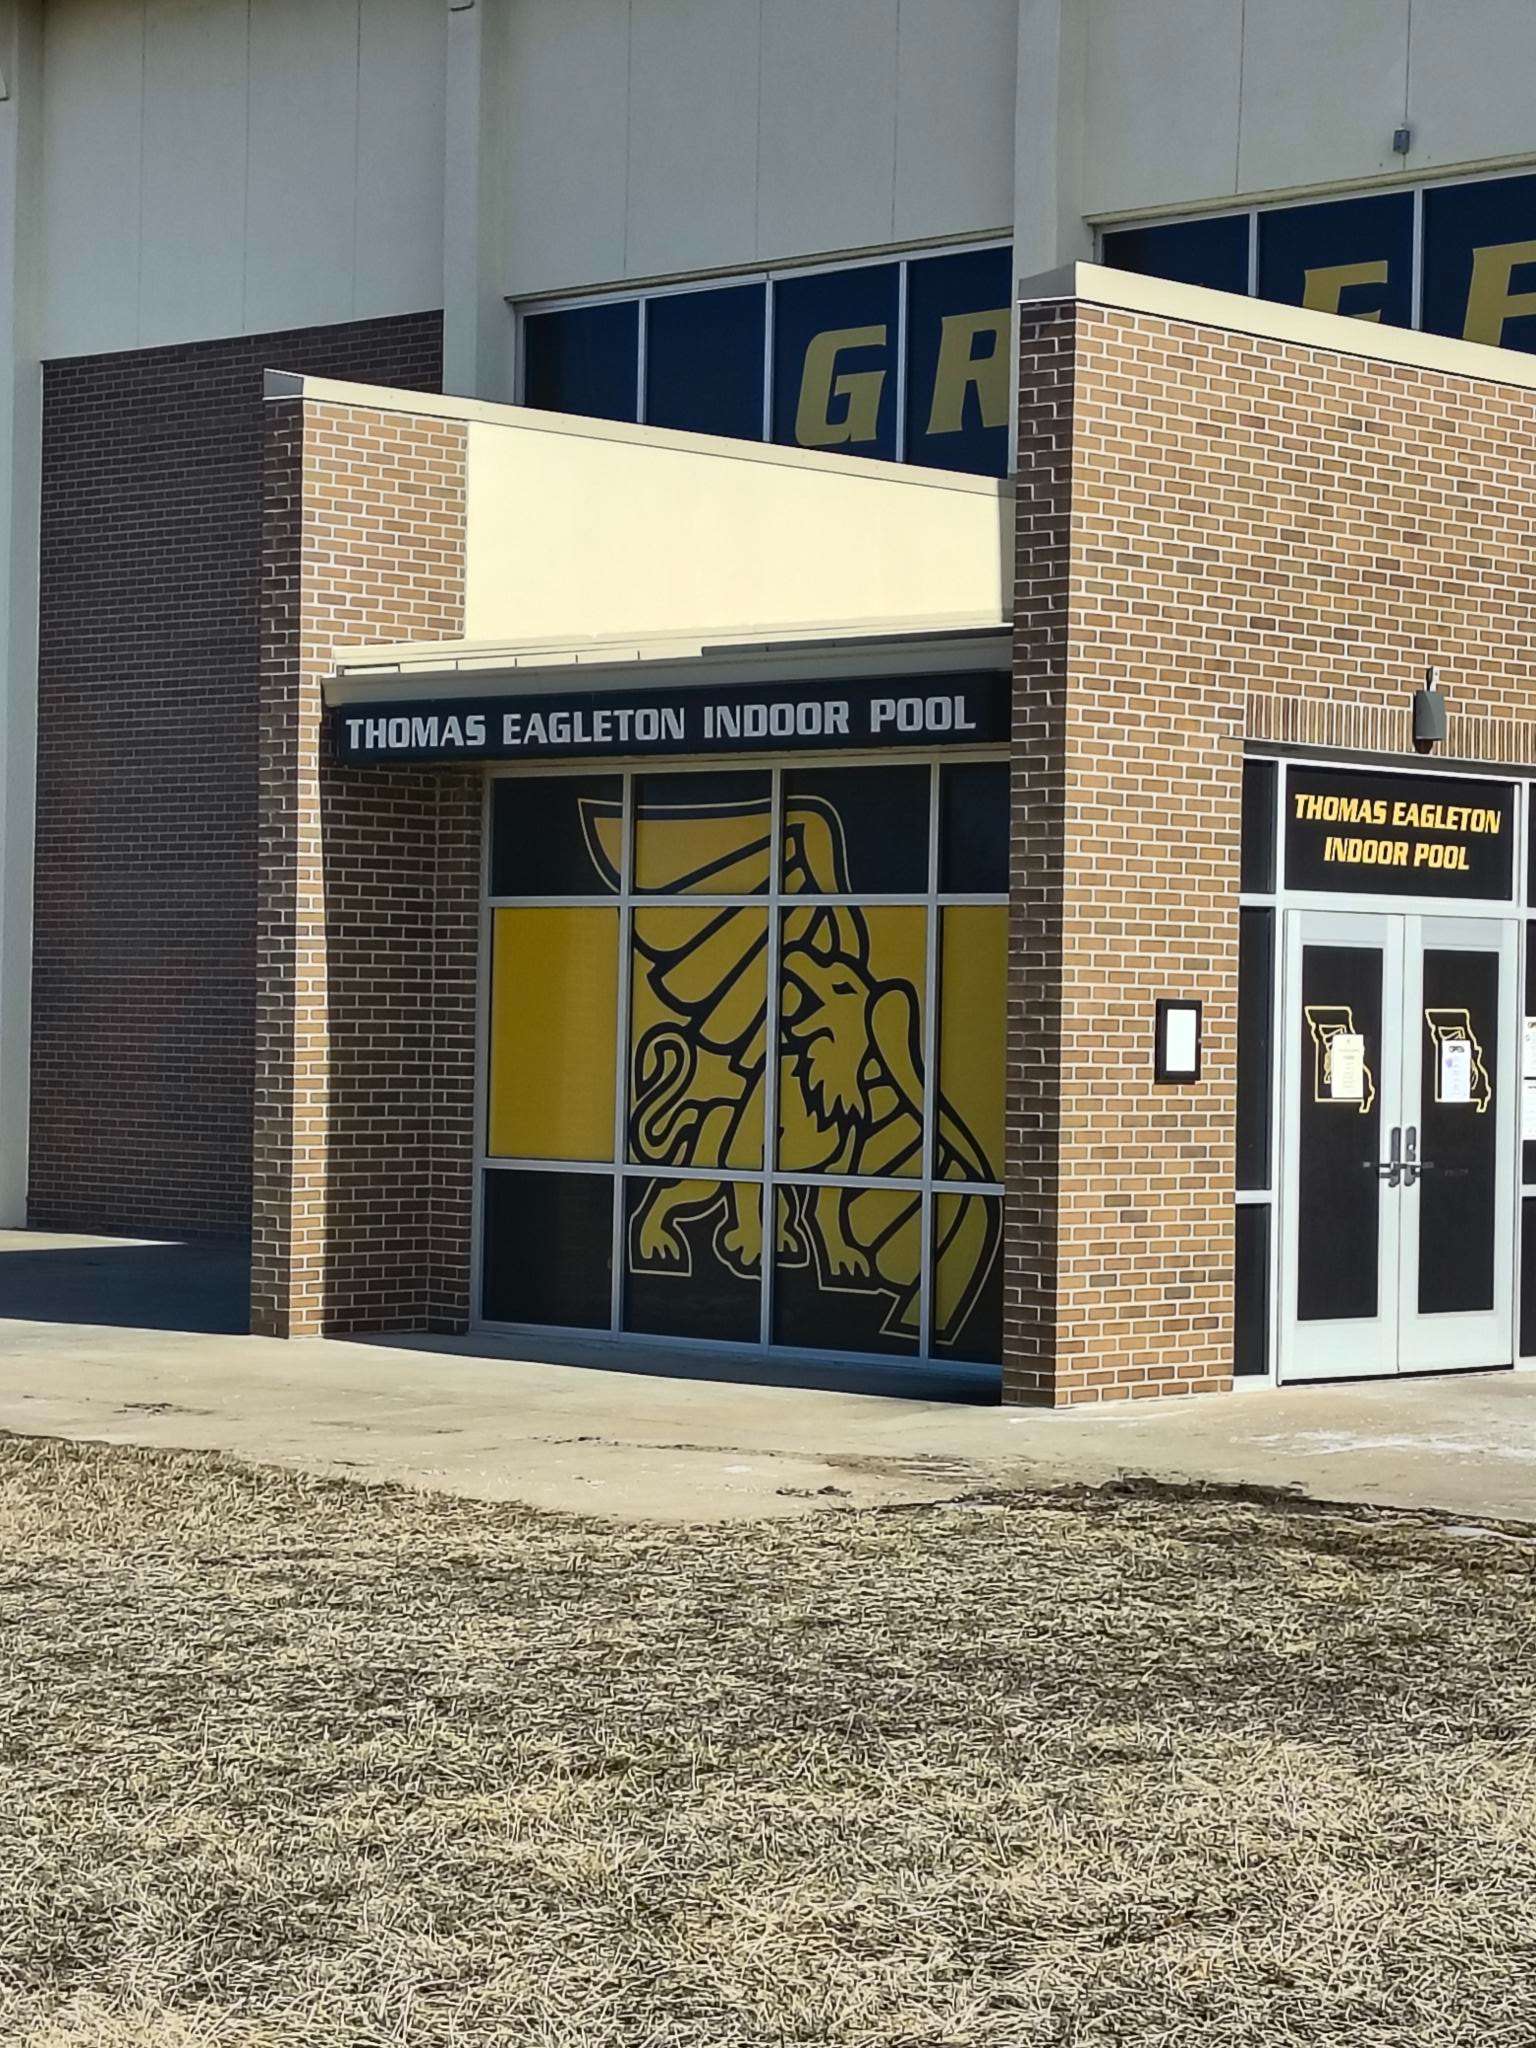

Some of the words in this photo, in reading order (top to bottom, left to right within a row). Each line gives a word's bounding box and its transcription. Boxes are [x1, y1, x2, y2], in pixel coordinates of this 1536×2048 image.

[345, 715, 486, 749] THOMAS
[503, 707, 685, 745] EAGLETON
[703, 701, 850, 739] INDOOR
[870, 695, 977, 733] POOL
[1294, 793, 1388, 825] THOMAS
[1391, 801, 1501, 834] EAGLETON
[1323, 836, 1409, 867] INDOOR
[1413, 843, 1470, 871] POOL
